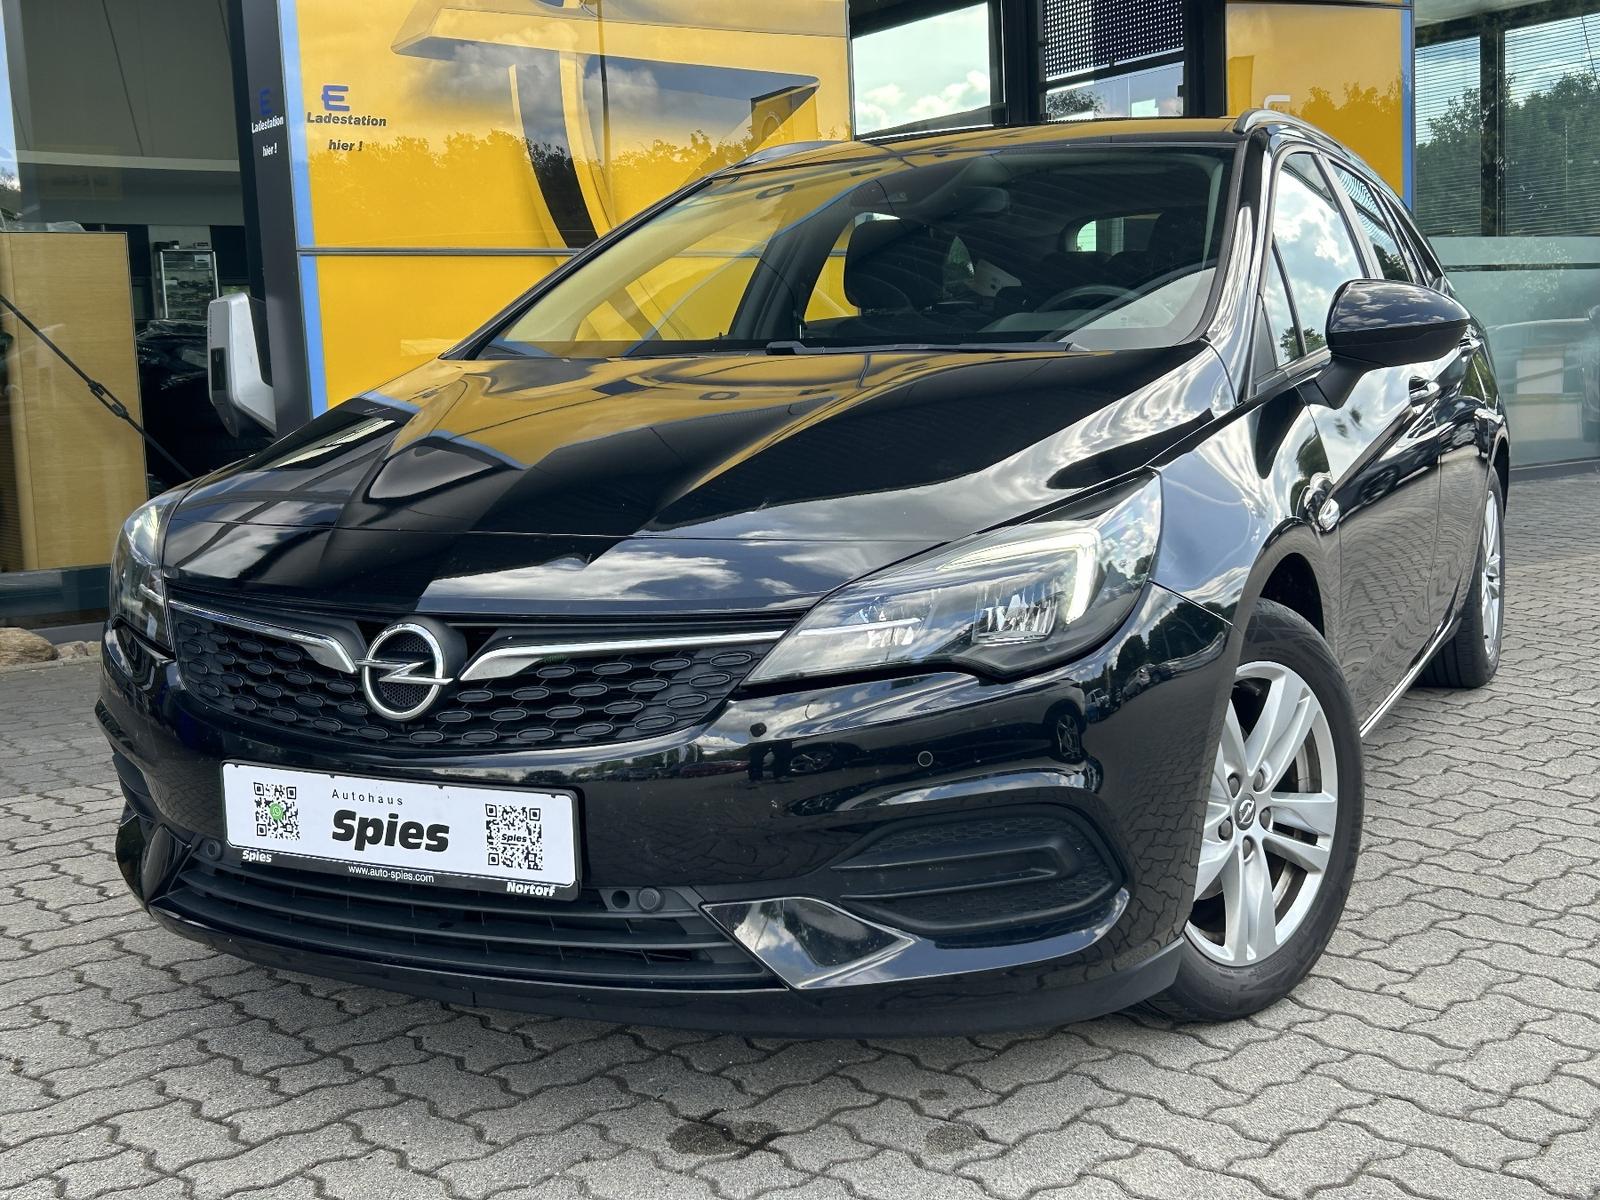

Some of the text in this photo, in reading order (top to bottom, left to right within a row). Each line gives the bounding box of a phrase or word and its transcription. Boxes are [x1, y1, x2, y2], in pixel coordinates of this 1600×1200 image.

[251, 115, 284, 134] Ladestation
[307, 112, 387, 126] Ladestation
[332, 788, 404, 807] Autohaus
[331, 809, 450, 852] Spies
[501, 833, 528, 844] Spies
[241, 849, 273, 864] Spies
[347, 864, 435, 884] www.auto-spies.com
[506, 881, 556, 898] Nortorf
